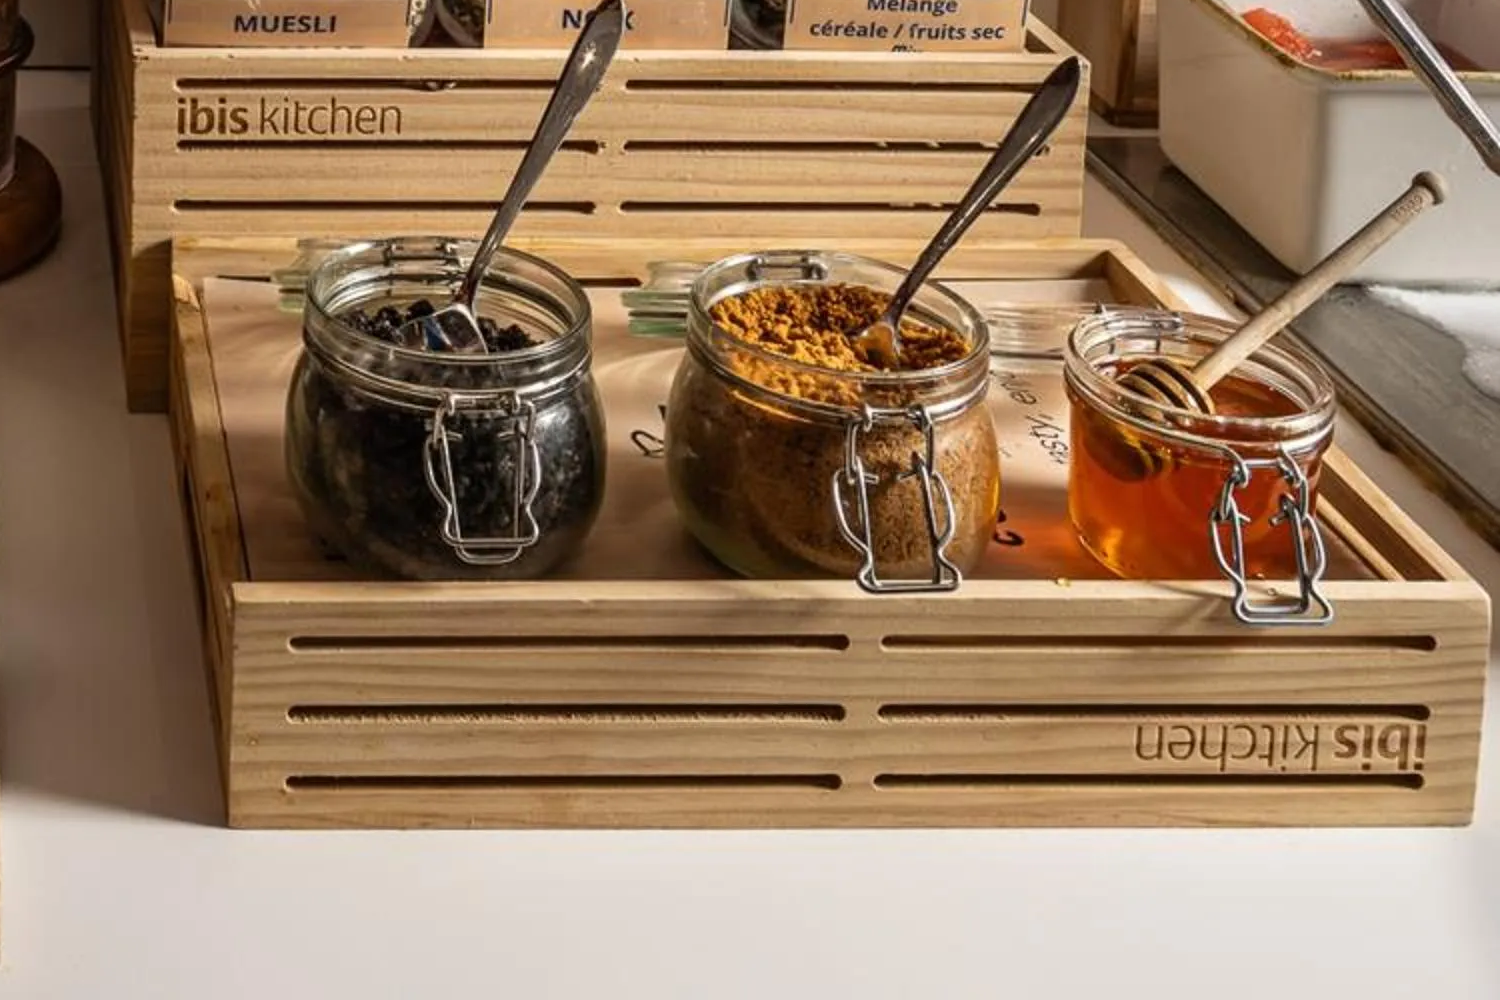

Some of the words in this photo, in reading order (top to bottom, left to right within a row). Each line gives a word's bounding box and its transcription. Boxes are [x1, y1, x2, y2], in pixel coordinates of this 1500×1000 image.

[233, 14, 337, 34] MUESLI
[809, 20, 888, 39] céréale
[908, 23, 967, 41] fruits
[970, 26, 1005, 40] sec
[176, 97, 249, 135] ibis
[259, 96, 402, 135] kitchen
[1134, 723, 1320, 773] kitchen
[1332, 723, 1428, 773] ibis
